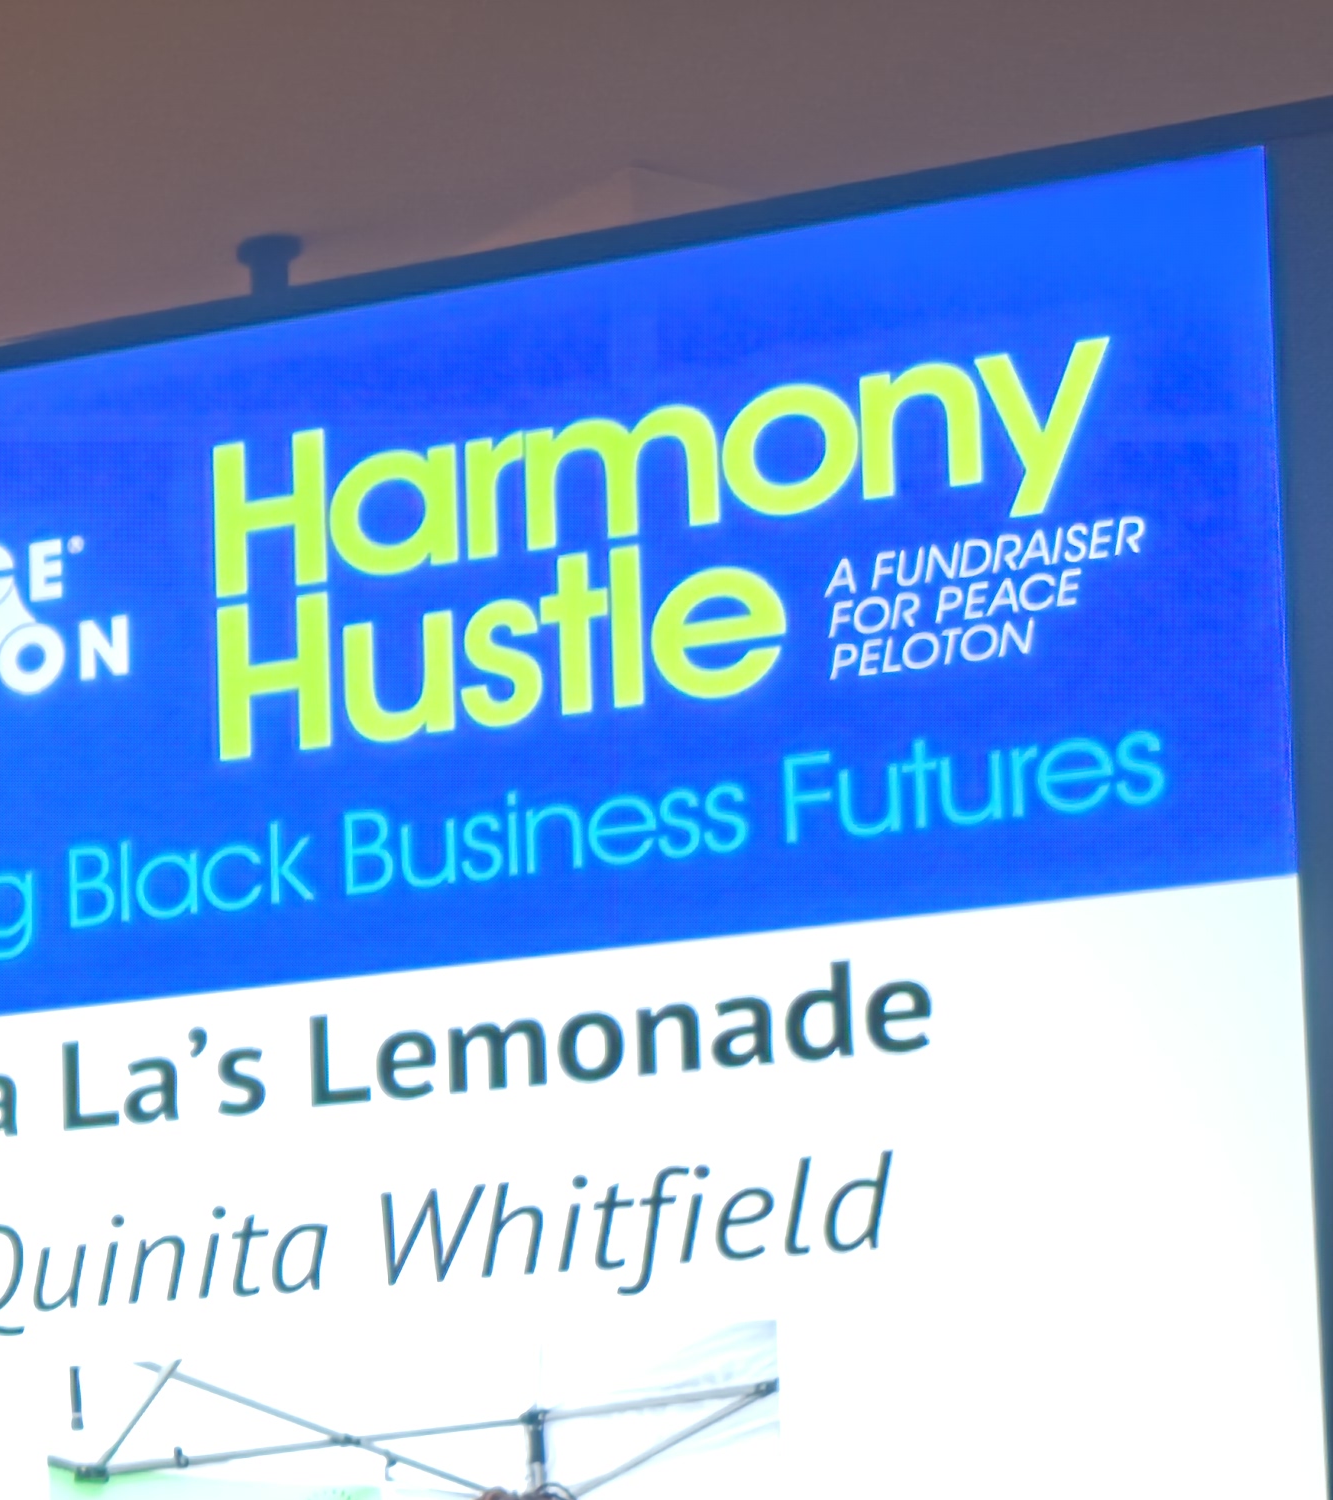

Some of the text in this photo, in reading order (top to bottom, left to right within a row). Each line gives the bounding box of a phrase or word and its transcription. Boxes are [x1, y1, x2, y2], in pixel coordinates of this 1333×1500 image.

[213, 336, 1110, 598] Harmony
[824, 516, 1145, 598] A FUNDRAISER
[828, 568, 1081, 638] FOR PEACE
[216, 545, 786, 761] Hustle
[829, 617, 1035, 680] PELOTON
[66, 823, 316, 929] Black
[343, 781, 746, 896] Business
[781, 729, 1166, 843] Futures
[62, 1027, 266, 1131] La’s
[309, 959, 933, 1107] Lemonade
[380, 1150, 893, 1295] Whitfield
